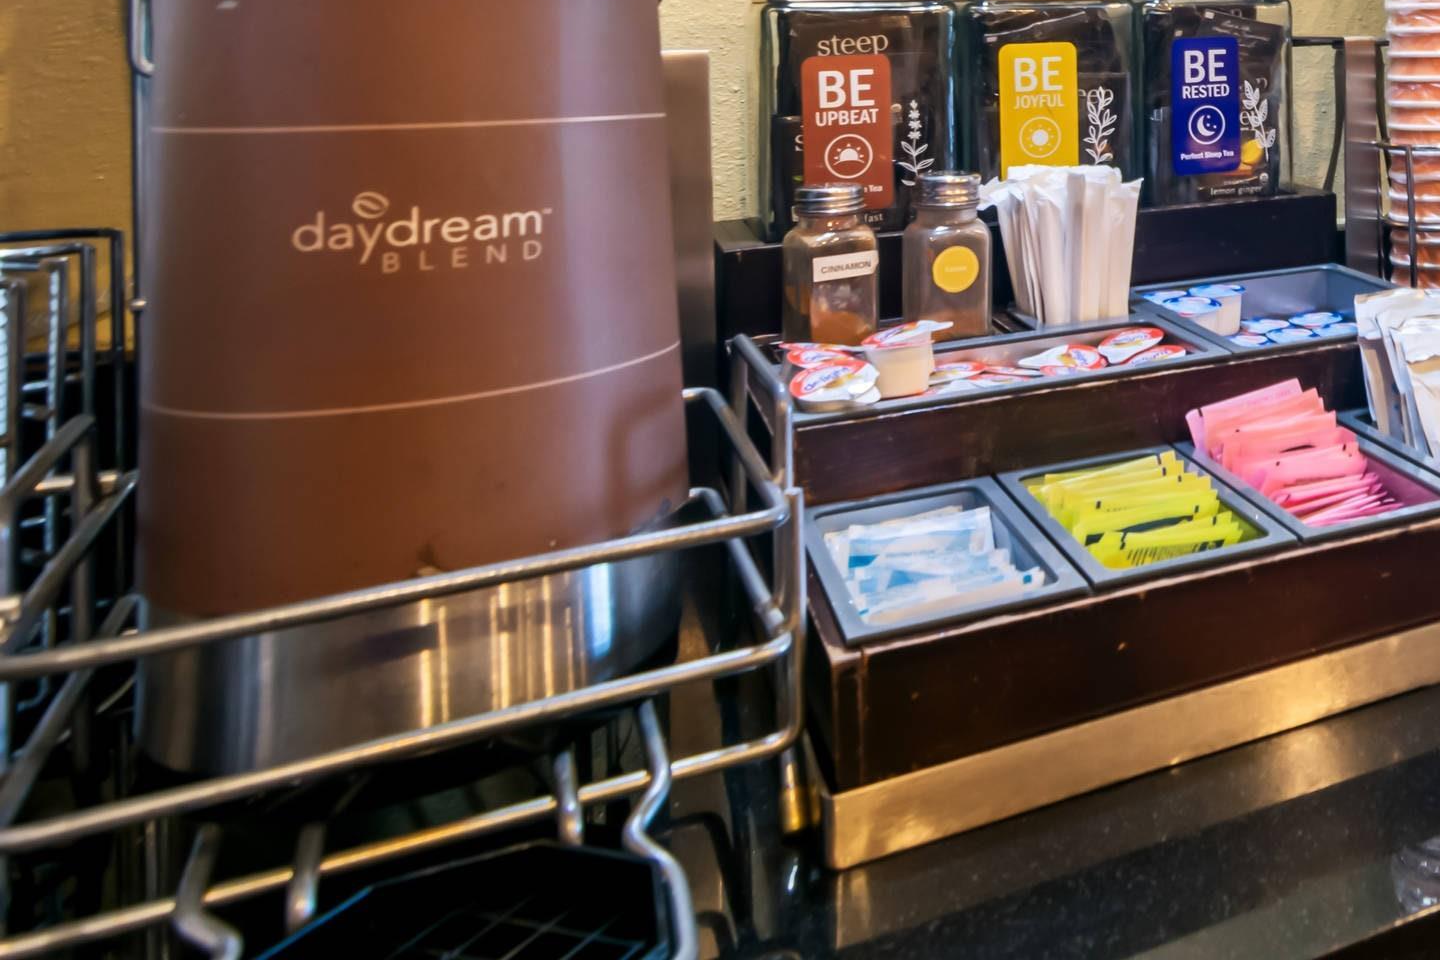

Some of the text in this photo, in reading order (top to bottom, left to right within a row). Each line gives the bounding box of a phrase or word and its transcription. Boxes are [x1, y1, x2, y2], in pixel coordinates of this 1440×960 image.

[816, 34, 889, 57] steep
[1013, 56, 1063, 93] BE
[1183, 49, 1228, 84] BE
[818, 68, 875, 109] BE
[1182, 83, 1230, 100] RESTED
[1014, 93, 1065, 110] JOYFUL
[815, 108, 880, 127] UPBEAT
[381, 239, 543, 274] BLEND
[820, 260, 872, 274] CINNAMON
